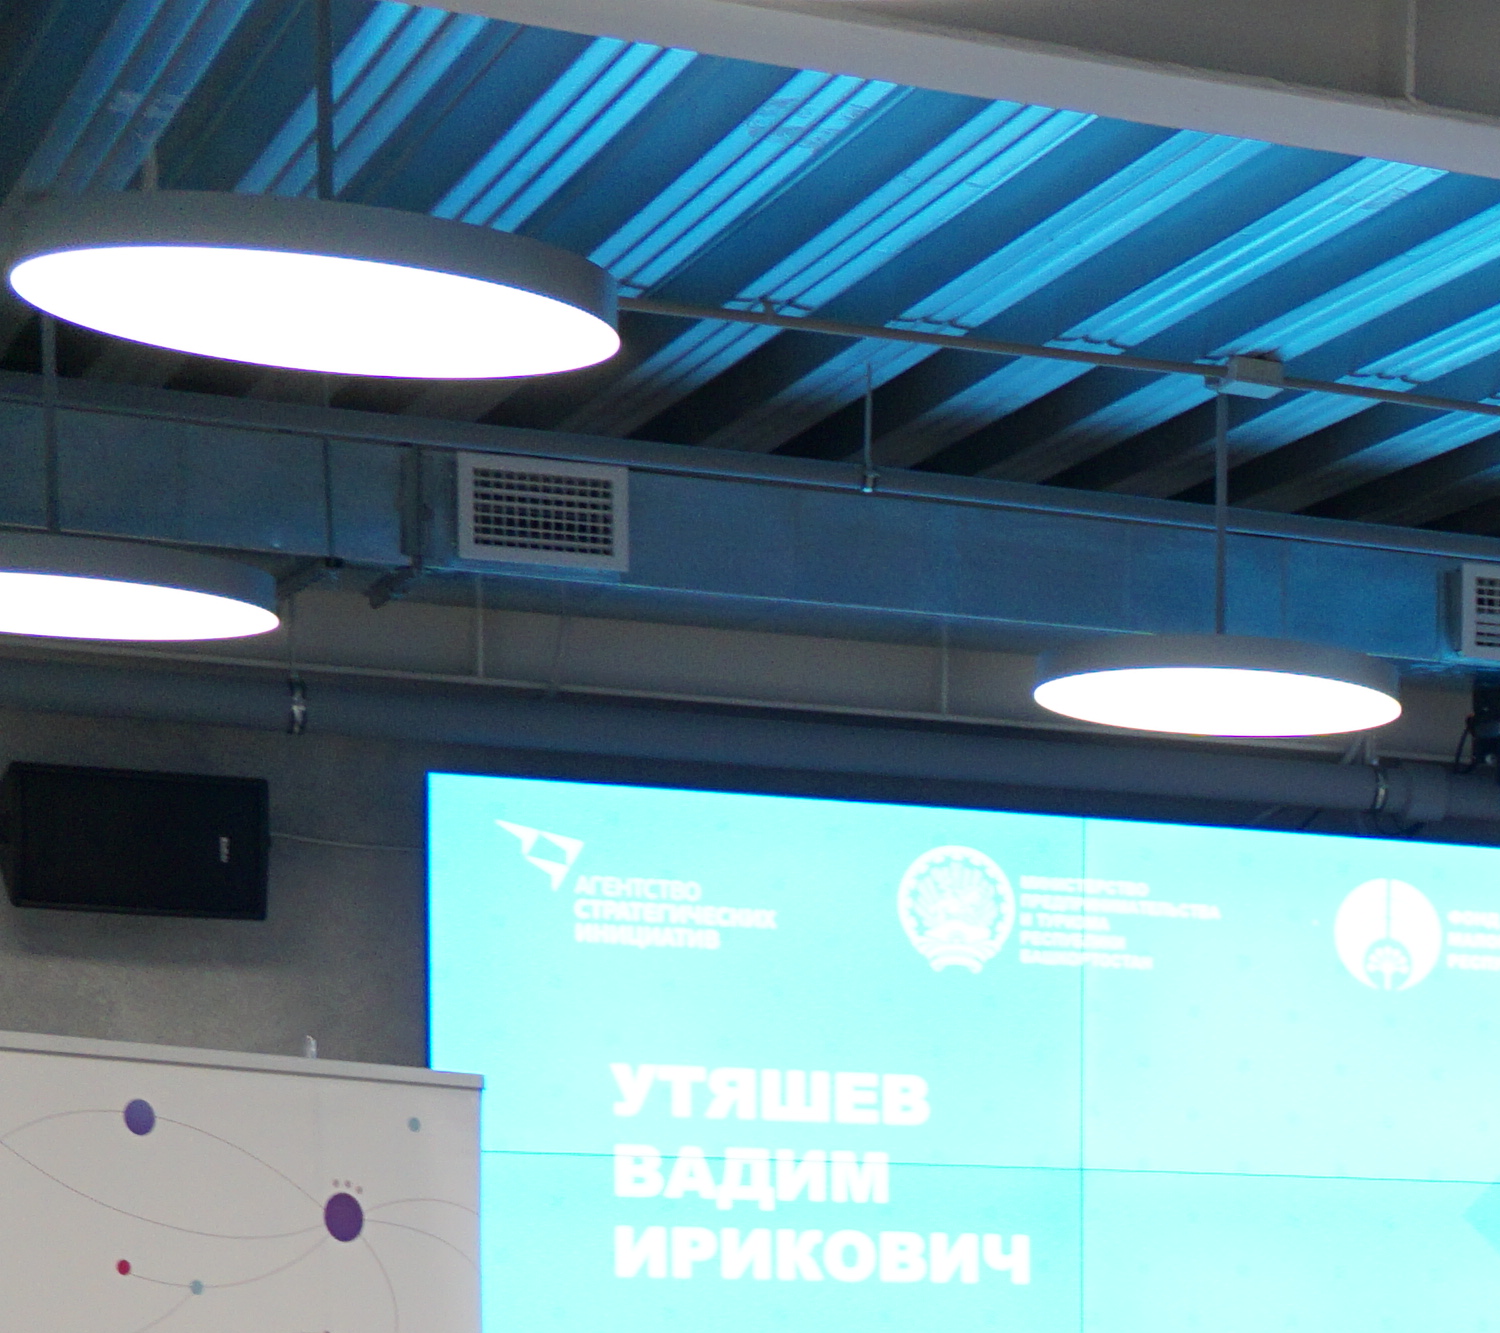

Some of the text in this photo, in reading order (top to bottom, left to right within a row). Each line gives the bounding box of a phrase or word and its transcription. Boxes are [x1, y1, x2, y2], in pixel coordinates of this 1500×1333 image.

[575, 875, 702, 902] АГЕНТСТВО
[574, 898, 778, 929] СТРАТЕГИЧЕСКИХ
[575, 923, 720, 949] ИНИЦИАТИВ
[609, 1061, 932, 1127] УТЯШЕВ
[613, 1143, 891, 1213] ВАДИМ
[613, 1225, 1032, 1286] ИРИКОВИЧ
